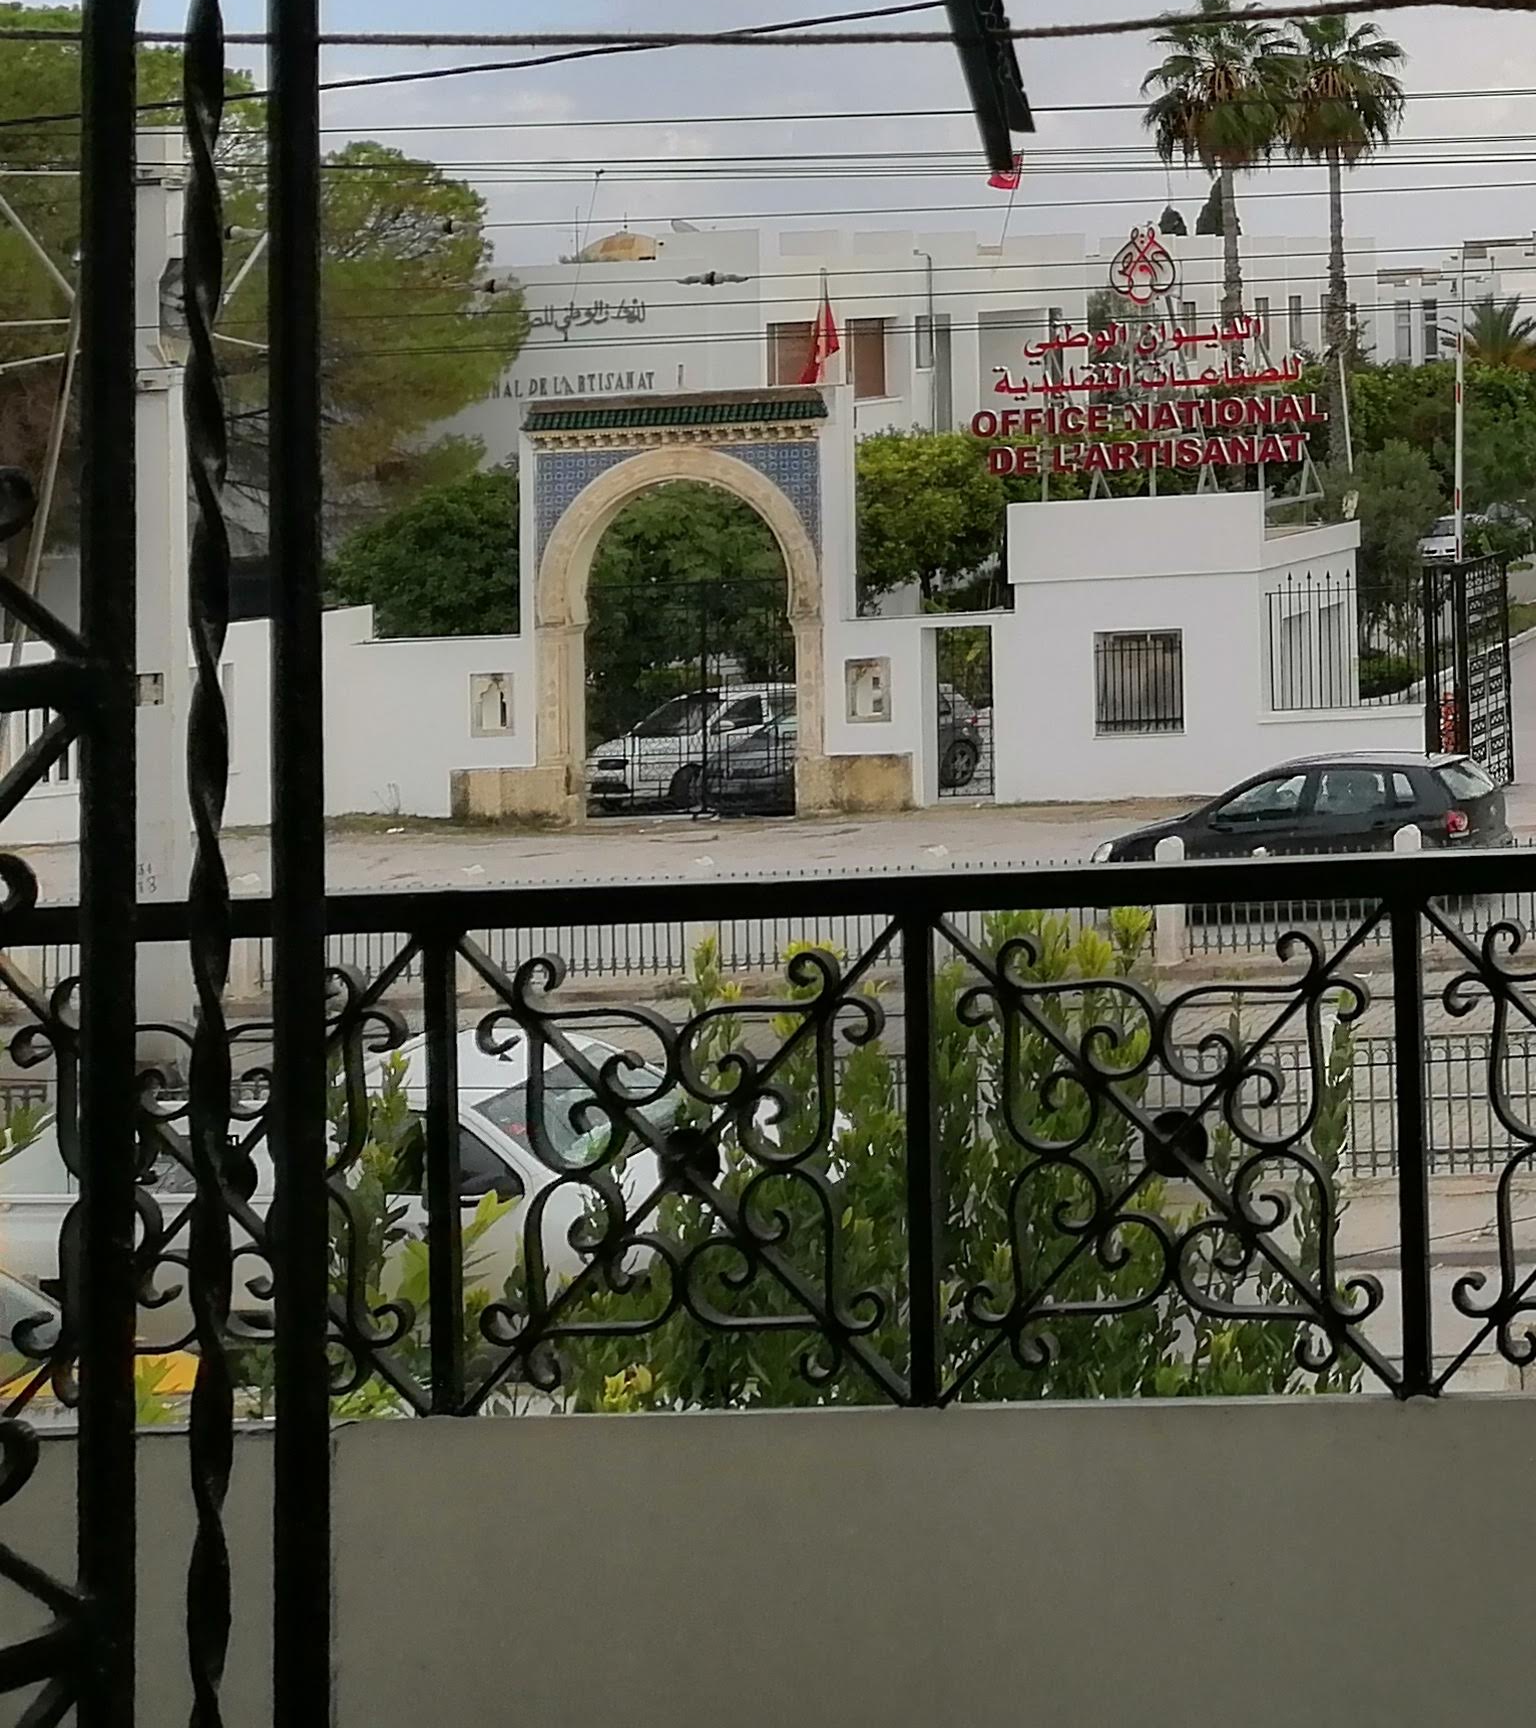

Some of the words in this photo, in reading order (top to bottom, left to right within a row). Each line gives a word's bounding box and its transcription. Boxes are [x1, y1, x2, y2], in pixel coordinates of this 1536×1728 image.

[1024, 319, 1129, 365] الوطني
[1136, 315, 1263, 355] الديوان
[528, 377, 548, 396] DE
[992, 363, 1133, 400] التقليدية
[1140, 351, 1303, 388] للصناعات
[971, 404, 1113, 438] OFFICE
[1124, 393, 1329, 430] NATIONAL
[988, 444, 1042, 475] DE
[1053, 432, 1310, 473] L'ARTISANAT
